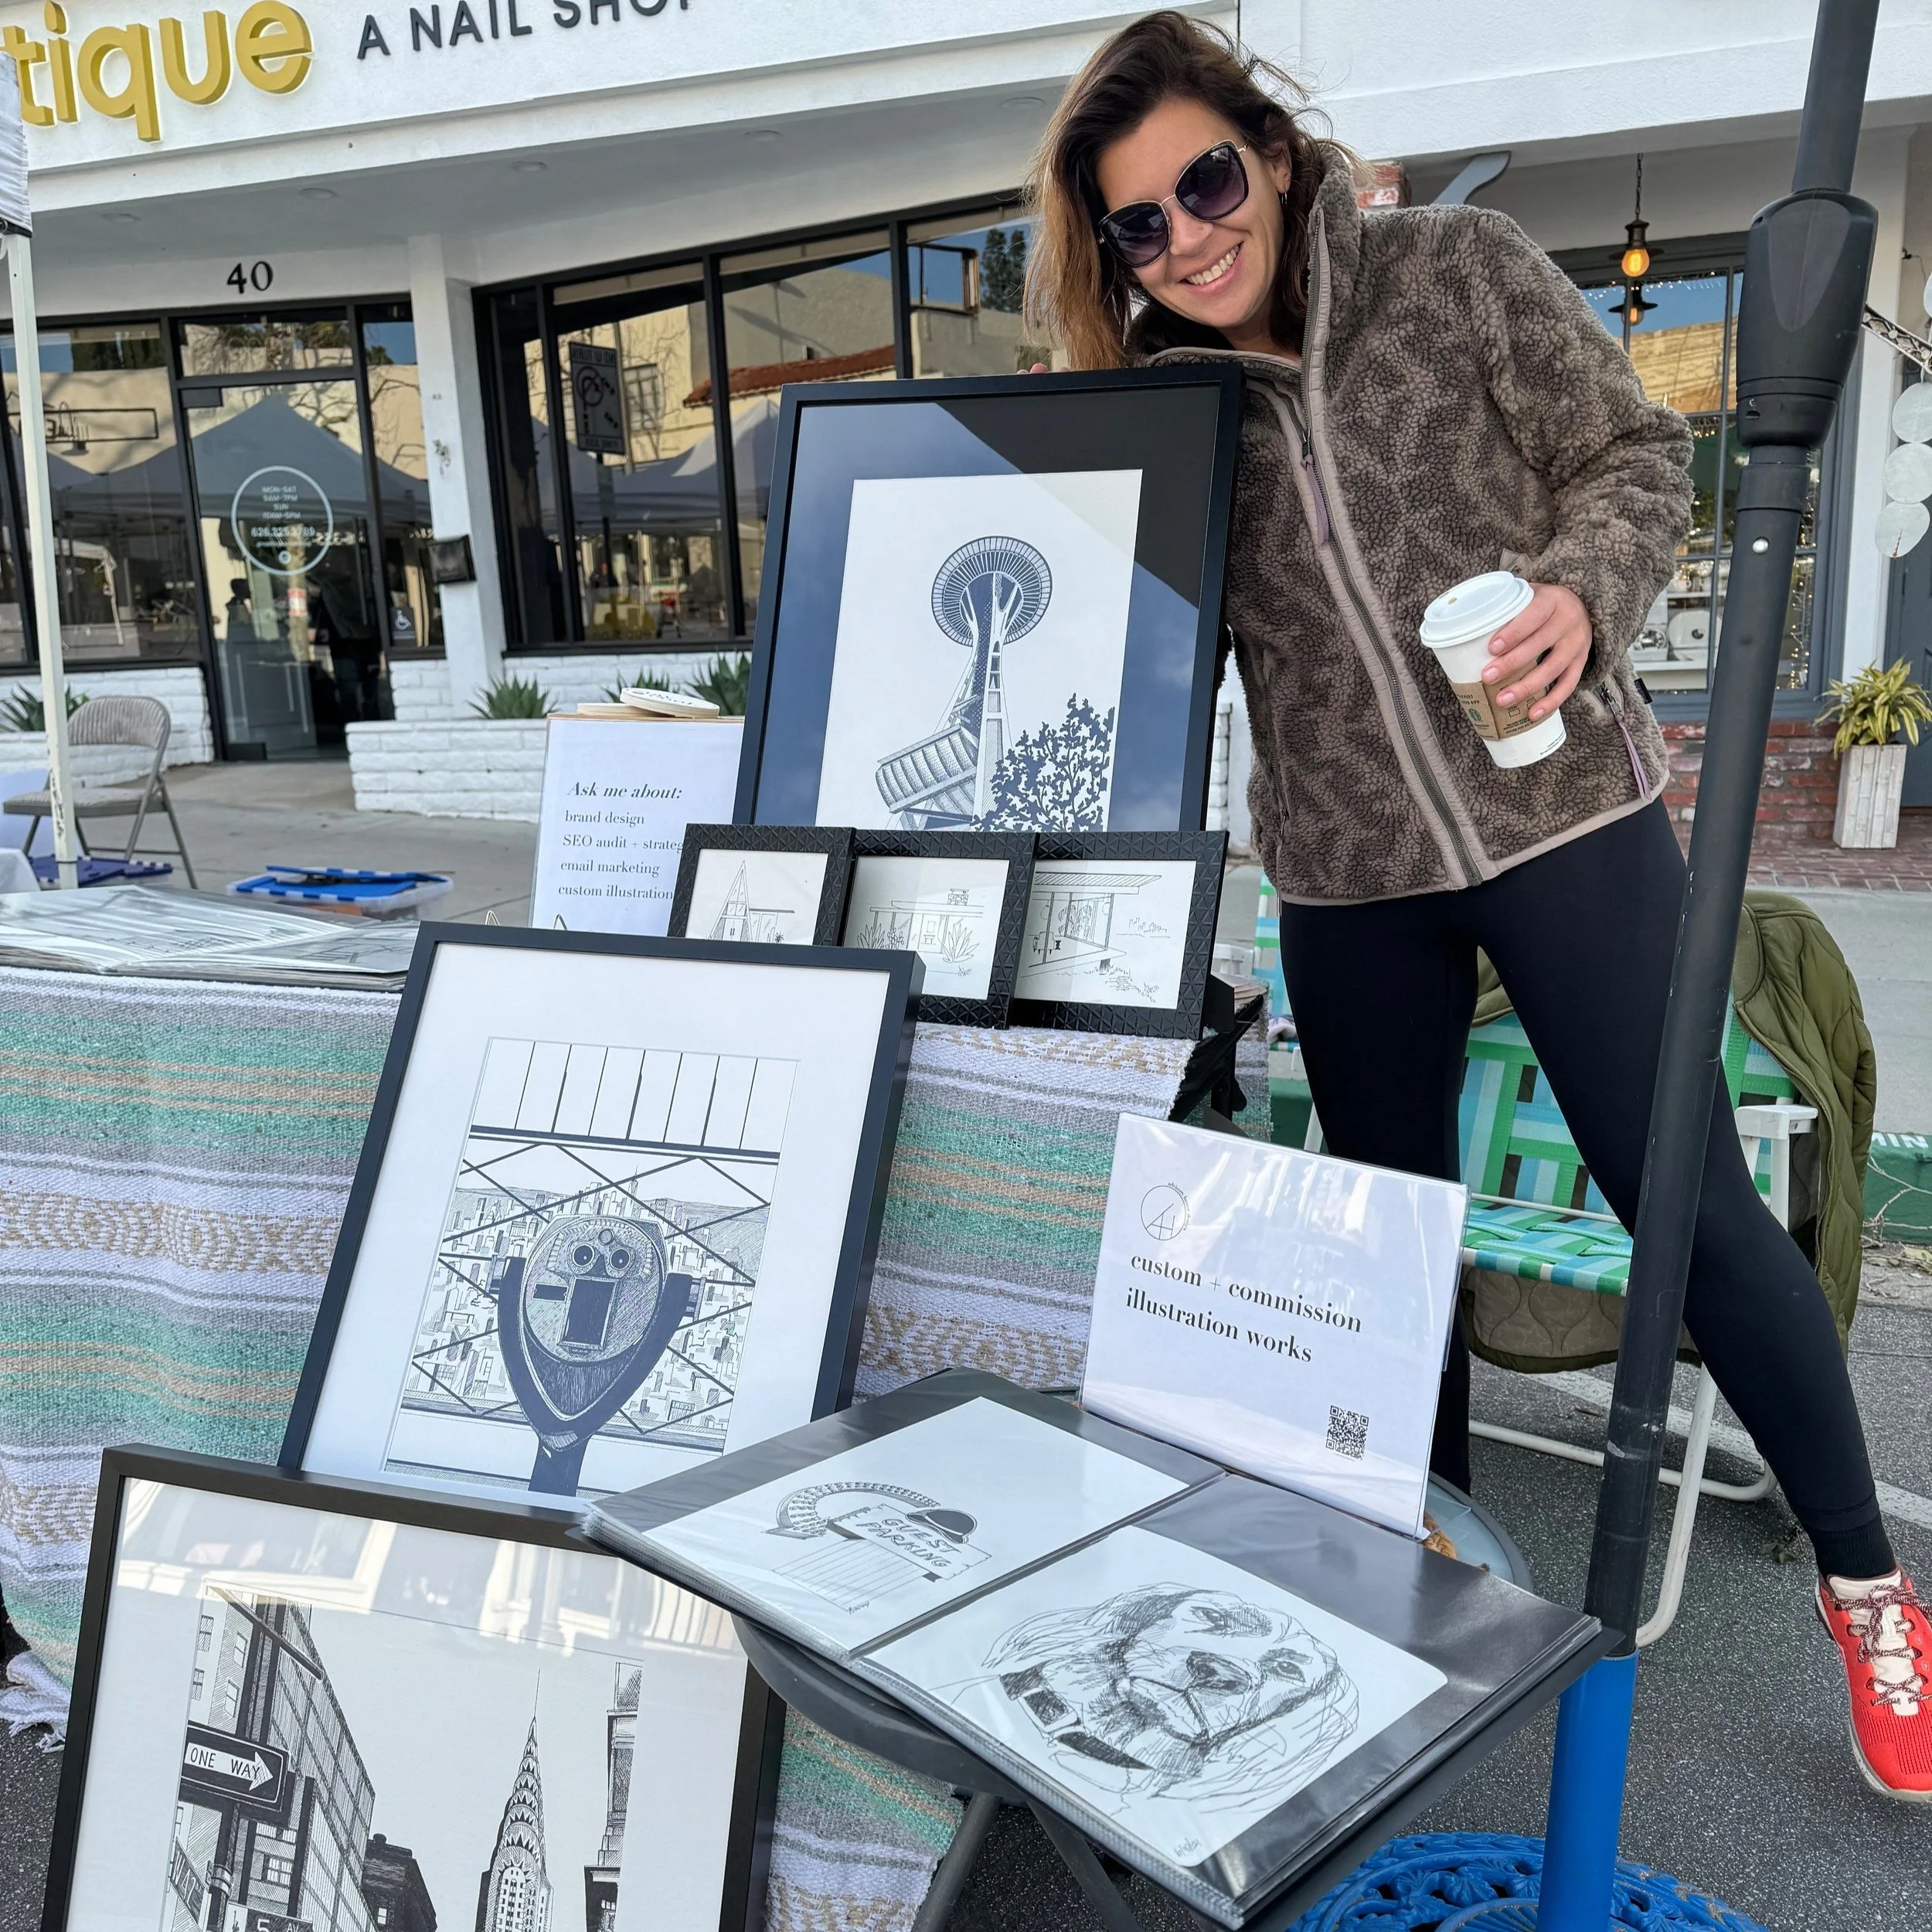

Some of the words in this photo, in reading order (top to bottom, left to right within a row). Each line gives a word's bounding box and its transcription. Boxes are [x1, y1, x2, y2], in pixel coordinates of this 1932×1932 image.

[357, 15, 390, 60] A
[410, 0, 532, 51] NAIL
[0, 0, 312, 142] tique
[226, 260, 273, 294] 40
[566, 781, 597, 796] Ask
[604, 787, 627, 798] me
[631, 784, 682, 799] about:
[565, 810, 600, 823] brand
[605, 812, 645, 828] design
[563, 835, 592, 847] SEO
[596, 836, 627, 849] audit
[560, 859, 594, 872] email
[597, 862, 660, 877] marketing
[558, 884, 602, 896] custom
[1131, 1253, 1202, 1288] custom
[1228, 1280, 1362, 1333] commission
[1126, 1287, 1239, 1341] illustration
[1247, 1331, 1312, 1363] works
[856, 1522, 951, 1568] PARKING
[882, 1518, 962, 1554] GUEST
[190, 1747, 216, 1769] ONE
[231, 1759, 260, 1781] WAY
